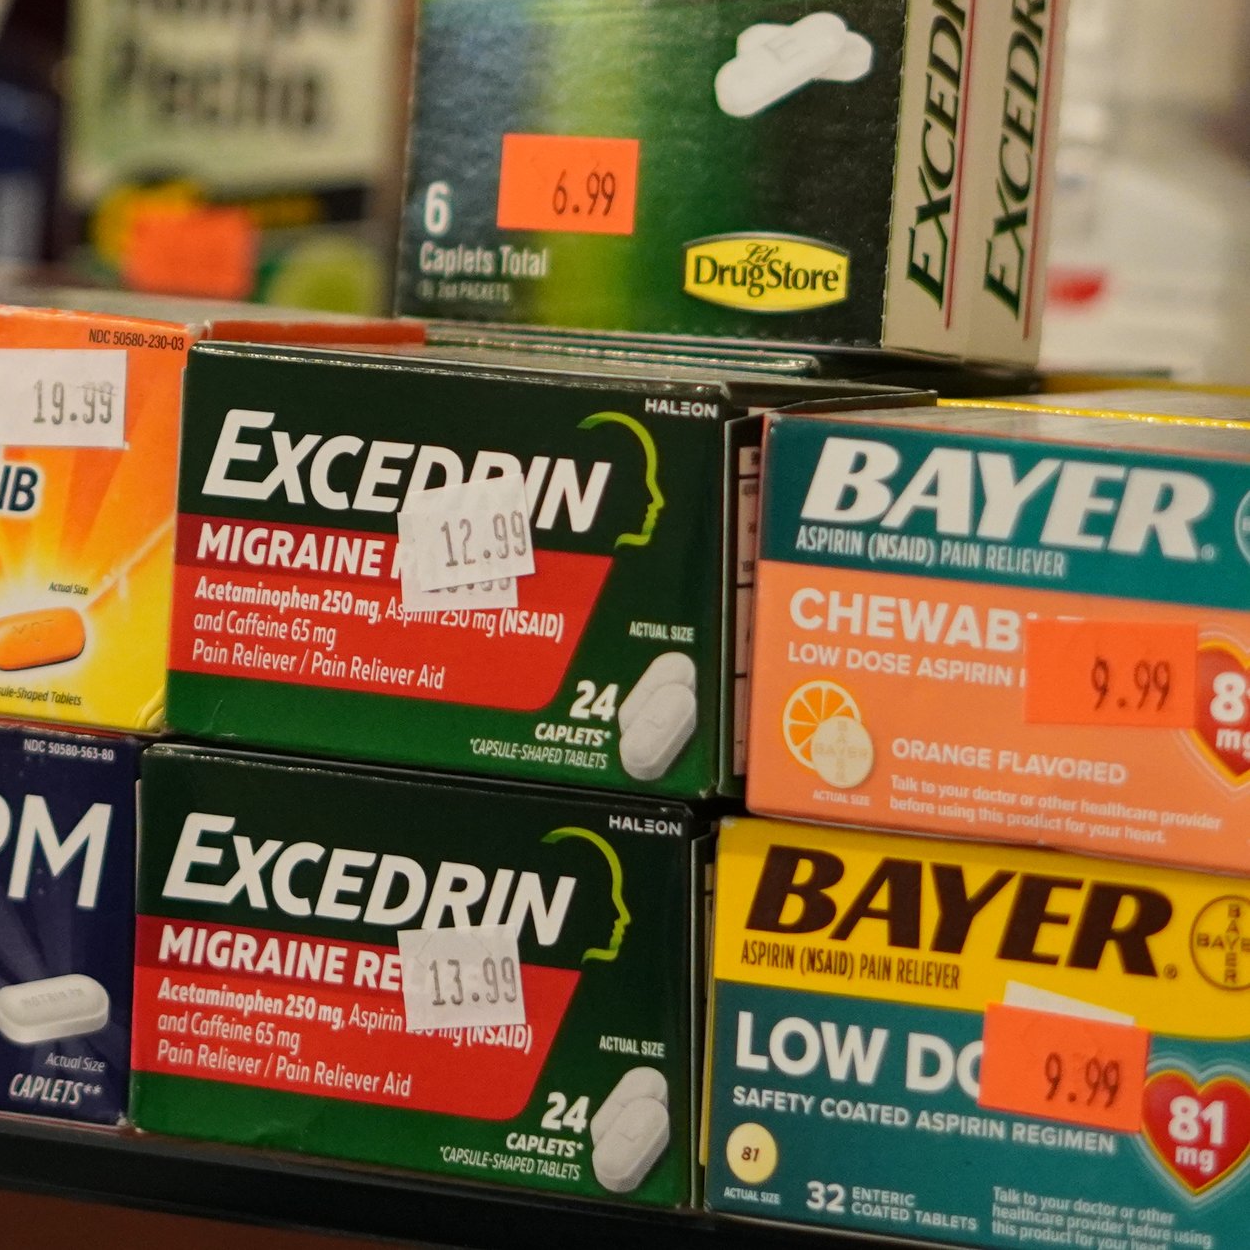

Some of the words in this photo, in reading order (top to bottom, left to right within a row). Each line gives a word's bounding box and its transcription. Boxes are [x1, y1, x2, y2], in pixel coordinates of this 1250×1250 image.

[424, 181, 450, 236] 6
[552, 169, 616, 216] 6.99
[420, 241, 495, 276] Caplets
[499, 245, 547, 276] Total
[89, 328, 110, 345] NDC
[113, 331, 184, 350] 50580-230-03
[33, 379, 116, 425] 19.99
[800, 436, 1213, 562] BAYER
[196, 522, 386, 577] MIGRAINE
[441, 510, 527, 567] 12.99
[795, 524, 864, 558] ASPIRIN
[867, 532, 937, 568] (NSAID)
[939, 540, 982, 569] PAIN
[985, 546, 1066, 578] RELIEVER
[193, 609, 224, 632] and
[226, 610, 288, 639] Caffeine
[291, 618, 311, 642] 65
[312, 626, 337, 652] mg
[195, 575, 319, 614] Acetaminophen
[321, 589, 352, 615] 250
[354, 598, 382, 625] mg,
[472, 612, 497, 637] mg
[499, 607, 564, 644] (NSAID)
[629, 621, 669, 639] ACTUAL
[670, 626, 695, 643] SIZE
[193, 638, 228, 665] Pain
[232, 642, 297, 672] Reliever
[311, 651, 346, 678] Pain
[350, 656, 415, 687] Reliever
[417, 664, 446, 690] Aid
[787, 641, 841, 667] LOW
[846, 648, 911, 676] DOSE
[916, 657, 1013, 688] ASPIRIN
[1091, 656, 1171, 712] 9.99
[51, 691, 82, 706] Tablets
[569, 680, 619, 722] 24
[24, 739, 45, 753] NDC
[48, 742, 114, 761] 50580-563-80
[563, 749, 607, 769] TABLETS
[892, 738, 991, 769] ORANGE
[998, 750, 1128, 786] FLAVORED
[890, 796, 935, 815] before
[938, 803, 976, 823] using
[979, 807, 1004, 824] this
[1006, 813, 1062, 832] product
[1064, 816, 1086, 834] for
[1088, 823, 1121, 840] your
[891, 774, 918, 793] Talk
[921, 781, 936, 795] to
[939, 784, 970, 799] your
[972, 785, 1017, 806] doctor
[1020, 793, 1035, 807] or
[1037, 794, 1077, 812] other
[1080, 799, 1157, 823] healthcare
[1161, 809, 1221, 831] provider
[162, 812, 577, 946] EXCEDRIN
[745, 844, 1173, 978] BAYER
[158, 924, 348, 985] MIGRAINE
[741, 939, 795, 969] ASPIRIN
[799, 947, 854, 980] (NSAID)
[859, 954, 891, 982] PAIN
[896, 958, 961, 990] RELIEVER
[429, 956, 517, 1006] 13.99
[157, 976, 283, 1018] Acetaminophen
[285, 993, 316, 1021] 250
[318, 1004, 345, 1031] mg,
[348, 1003, 403, 1035] Aspirin
[158, 1011, 189, 1034] and
[190, 1011, 252, 1042] Caffeine
[255, 1021, 275, 1045] 65
[276, 1030, 301, 1056] mg
[466, 1023, 533, 1055] (NSAID)
[599, 1035, 639, 1054] ACTUAL
[641, 1041, 665, 1058] SIZE
[736, 1011, 889, 1085] LOW
[46, 1053, 80, 1069] Actual
[82, 1056, 106, 1072] Size
[157, 1038, 193, 1065] Pain
[197, 1044, 261, 1076] Reliever
[276, 1055, 310, 1082] Pain
[314, 1061, 380, 1093] Reliever
[382, 1070, 411, 1097] Aid
[1045, 1052, 1121, 1109] 9.99
[541, 1091, 590, 1134] 24
[733, 1085, 815, 1116] SAFETY
[821, 1097, 910, 1128] COATED
[915, 1110, 1005, 1141] ASPIRIN
[1012, 1123, 1116, 1155] REGIMEN
[1169, 1095, 1226, 1146] 81
[536, 1161, 581, 1181] TABLETS
[741, 1146, 760, 1163] 81
[1175, 1145, 1215, 1174] mg
[724, 1186, 759, 1202] ACTUAL
[760, 1189, 781, 1205] SIZE
[806, 1180, 846, 1213] 32
[851, 1201, 910, 1222] COATED
[914, 1210, 978, 1231] TABLETS
[852, 1186, 916, 1207] ENTERIC
[993, 1186, 1020, 1202] Talk
[1023, 1192, 1037, 1206] to
[1040, 1195, 1071, 1210] your
[1074, 1199, 1117, 1218] doctor
[1120, 1206, 1134, 1219] or
[1138, 1210, 1175, 1225] other
[992, 1204, 1065, 1226] healthcare
[1067, 1215, 1125, 1236] provider
[1127, 1223, 1172, 1242] before
[1174, 1233, 1213, 1250] using
[992, 1219, 1016, 1237] this
[1020, 1226, 1072, 1247] product
